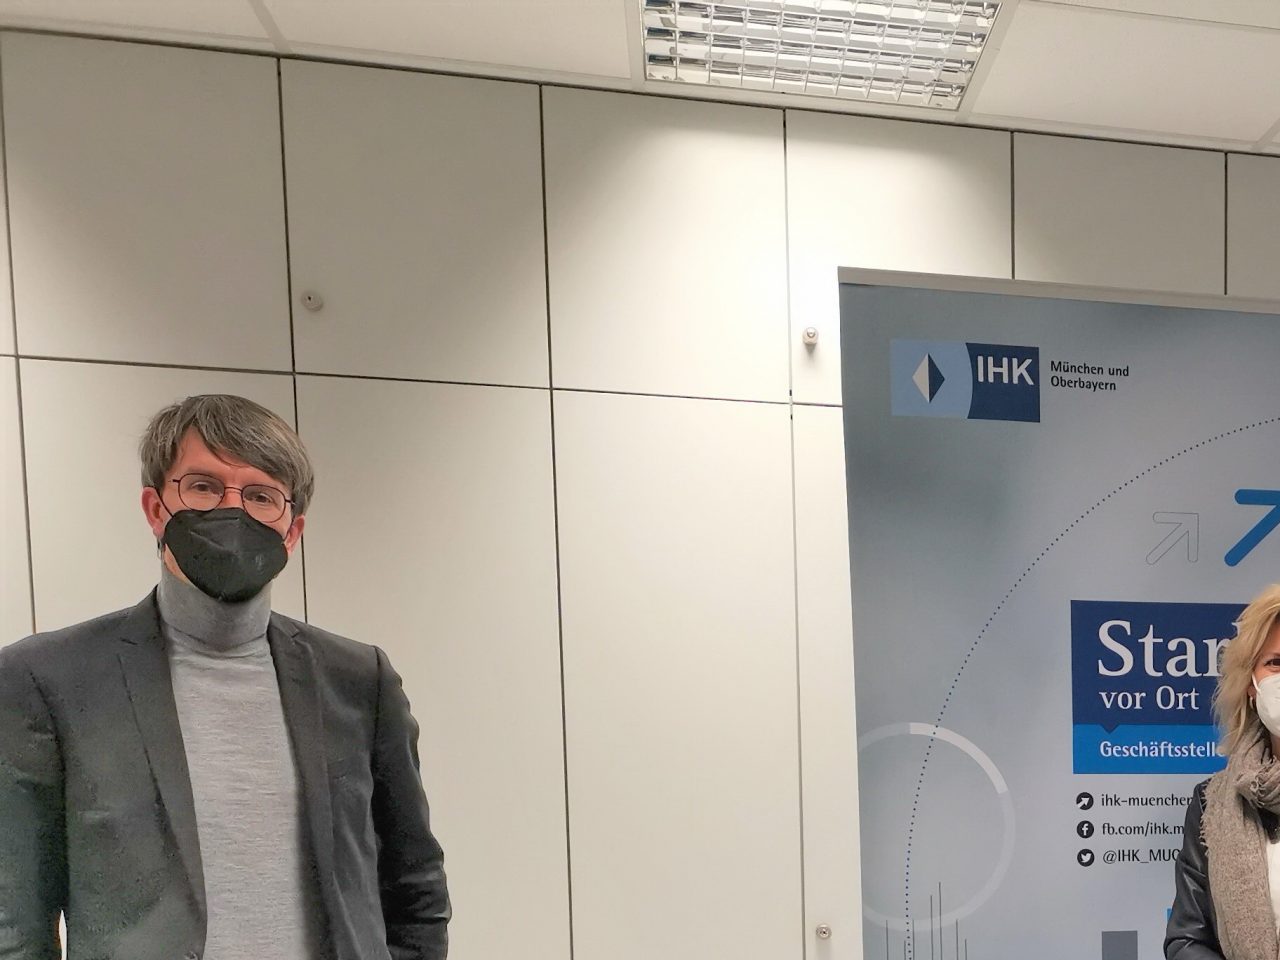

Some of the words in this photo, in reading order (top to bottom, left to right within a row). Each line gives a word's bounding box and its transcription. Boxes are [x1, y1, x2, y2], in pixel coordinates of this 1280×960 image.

[977, 355, 1035, 386] IHK
[1050, 360, 1104, 376] München
[1108, 364, 1130, 377] und
[1050, 375, 1117, 393] Oberbayern
[1097, 619, 1241, 678] Star
[1099, 690, 1147, 710] vor
[1156, 685, 1200, 710] Ort
